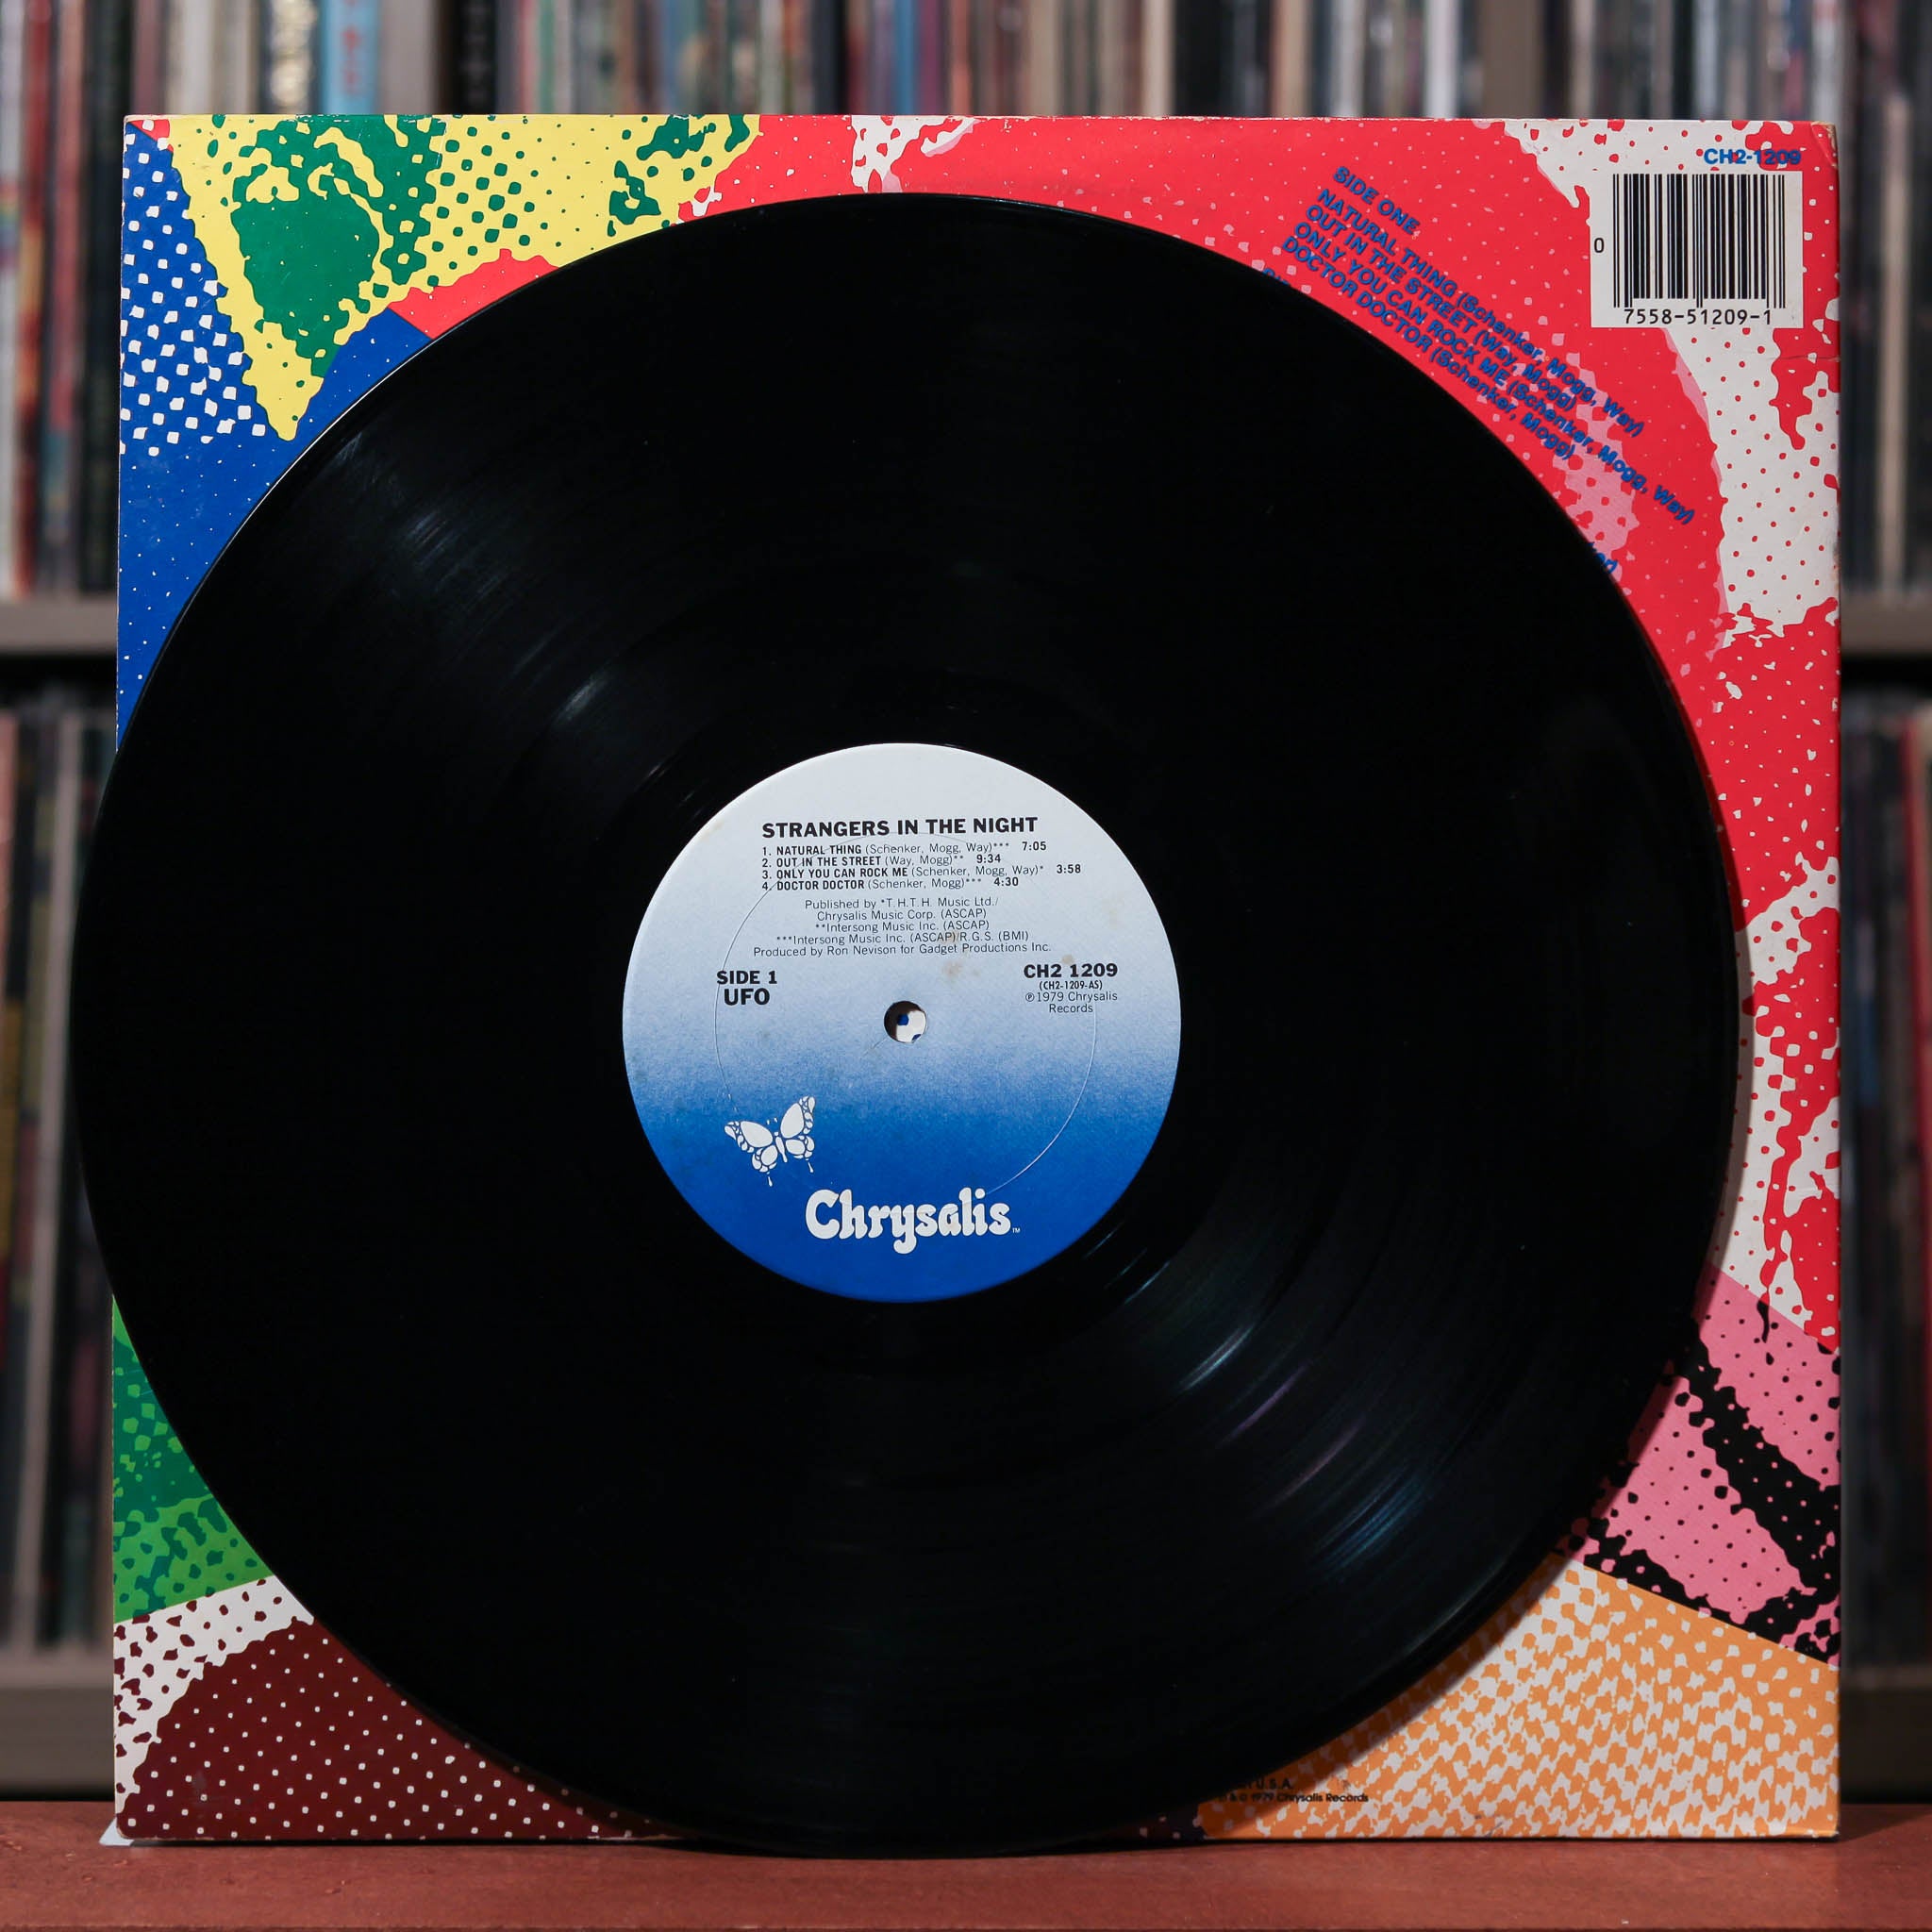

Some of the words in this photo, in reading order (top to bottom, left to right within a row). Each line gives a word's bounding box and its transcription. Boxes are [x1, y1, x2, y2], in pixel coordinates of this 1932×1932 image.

[1704, 148, 1801, 165] CH2-1209
[1333, 166, 1379, 205] SIDE
[1377, 199, 1421, 235] ONE
[1593, 237, 1605, 253] 0
[1307, 205, 1347, 237] OUT
[1344, 232, 1368, 255] IN
[1369, 248, 1407, 284] THE
[1405, 277, 1477, 333] STREET
[1473, 329, 1518, 373] (Way,
[1523, 363, 1576, 411] Mogg)
[1317, 189, 1396, 256] NATURAL
[1401, 248, 1457, 297] THING
[1456, 292, 1543, 365] (Schenker,
[1547, 358, 1597, 407] Mogg,
[1603, 397, 1644, 438] Way)
[1624, 308, 1771, 325] 7558-51209-1
[1282, 236, 1358, 298] DOCTOR
[1356, 291, 1432, 352] DOCTOR
[1429, 346, 1518, 420] (Schenker,
[1521, 412, 1576, 460] Mogg)
[1294, 222, 1346, 263] ONLY
[1349, 259, 1388, 294] YOU
[1386, 290, 1427, 325] CAN
[1427, 320, 1480, 364] ROCK
[1479, 358, 1509, 387] ME
[1507, 380, 1594, 454] (Schenker,
[1598, 444, 1648, 493] Mogg,
[1653, 484, 1695, 525] Way)
[762, 820, 890, 838] STRANGERS
[897, 819, 919, 835] IN
[925, 818, 967, 835] THE
[973, 817, 1039, 834] NIGHT
[762, 846, 772, 857] 1.
[776, 845, 825, 856] NATURAL
[830, 844, 862, 855] THING
[865, 843, 924, 855] (Schenker,
[929, 842, 961, 854] Mogg,
[1022, 841, 1047, 851] 7:05
[762, 858, 772, 868] 2.
[776, 858, 797, 867] OUT
[802, 857, 812, 867] IN
[817, 857, 838, 866] THE
[841, 856, 881, 866] STREET
[885, 856, 914, 866] (Way,
[976, 854, 1001, 864] 9:34
[762, 870, 772, 879] 3.
[776, 869, 804, 879] ONLY
[808, 869, 829, 878] YOU
[834, 868, 856, 878] CAN
[859, 868, 888, 877] ROCK
[892, 867, 908, 876] ME
[911, 866, 970, 877] (Schenker,
[975, 865, 1007, 876] Mogg,
[1056, 864, 1081, 874] 3:58
[762, 881, 772, 891] 4.
[776, 880, 819, 891] DOCTOR
[823, 880, 864, 890] DOCTOR
[867, 878, 926, 890] (Schenker,
[993, 876, 1019, 887] 4:30
[805, 899, 859, 909] Published
[864, 898, 876, 909] by
[938, 897, 970, 907] Music
[817, 910, 867, 923] Chrysalis
[871, 909, 903, 920] Music
[908, 909, 936, 921] Corp.
[941, 908, 987, 919] (ASCAP)
[882, 921, 914, 931] Music
[920, 921, 939, 930] Inc.
[943, 920, 990, 931] (ASCAP)
[849, 933, 881, 943] Music
[886, 933, 906, 943] Inc.
[998, 930, 1029, 941] (BMI)
[754, 947, 806, 957] Produced
[810, 946, 823, 958] by
[827, 946, 848, 956] Ron
[853, 945, 896, 955] Nevison
[900, 944, 914, 954] for
[919, 943, 958, 955] Gadget
[962, 941, 1027, 953] Productions
[1032, 942, 1052, 952] Inc.
[717, 970, 760, 985] SIDE
[768, 970, 777, 984] 1
[1024, 963, 1062, 978] CH2
[1070, 962, 1118, 977] 1209
[1039, 980, 1103, 991] (CH2-1209-AS)
[724, 988, 770, 1006] UFO
[1068, 991, 1118, 1003] Chrysalis
[1049, 1004, 1093, 1013] Records
[805, 1187, 1012, 1255] Chrysalis
[1277, 1792, 1323, 1804] Chrysalis
[1326, 1792, 1369, 1803] Records
